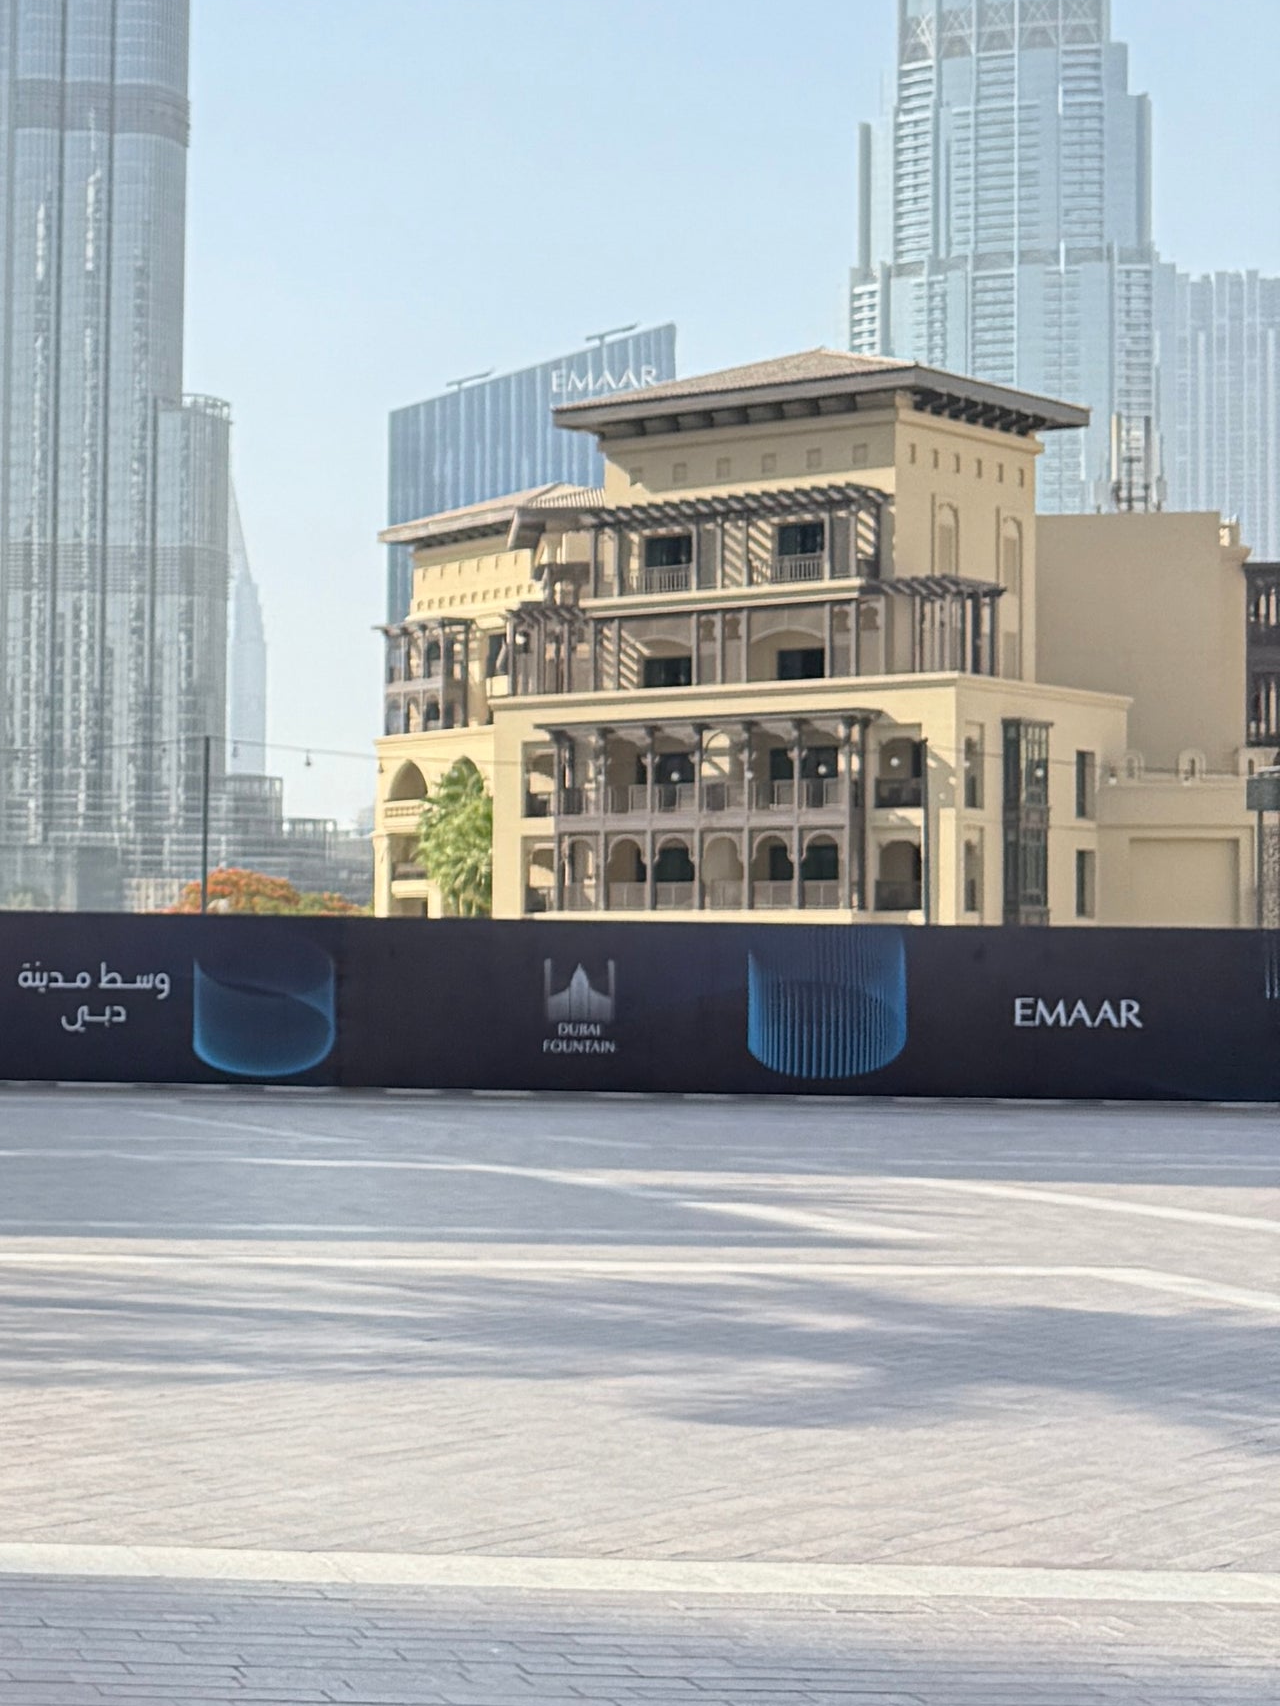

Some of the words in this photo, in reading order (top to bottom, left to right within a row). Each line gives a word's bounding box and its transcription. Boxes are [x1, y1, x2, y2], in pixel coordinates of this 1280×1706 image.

[551, 365, 657, 393] EMAAR
[17, 960, 91, 993] مدينة
[98, 961, 171, 1000] وسط
[60, 1004, 127, 1033] دبي
[1014, 997, 1143, 1028] EMAAR
[558, 1021, 601, 1037] DUBAI
[542, 1038, 616, 1054] FOUNTAIN
